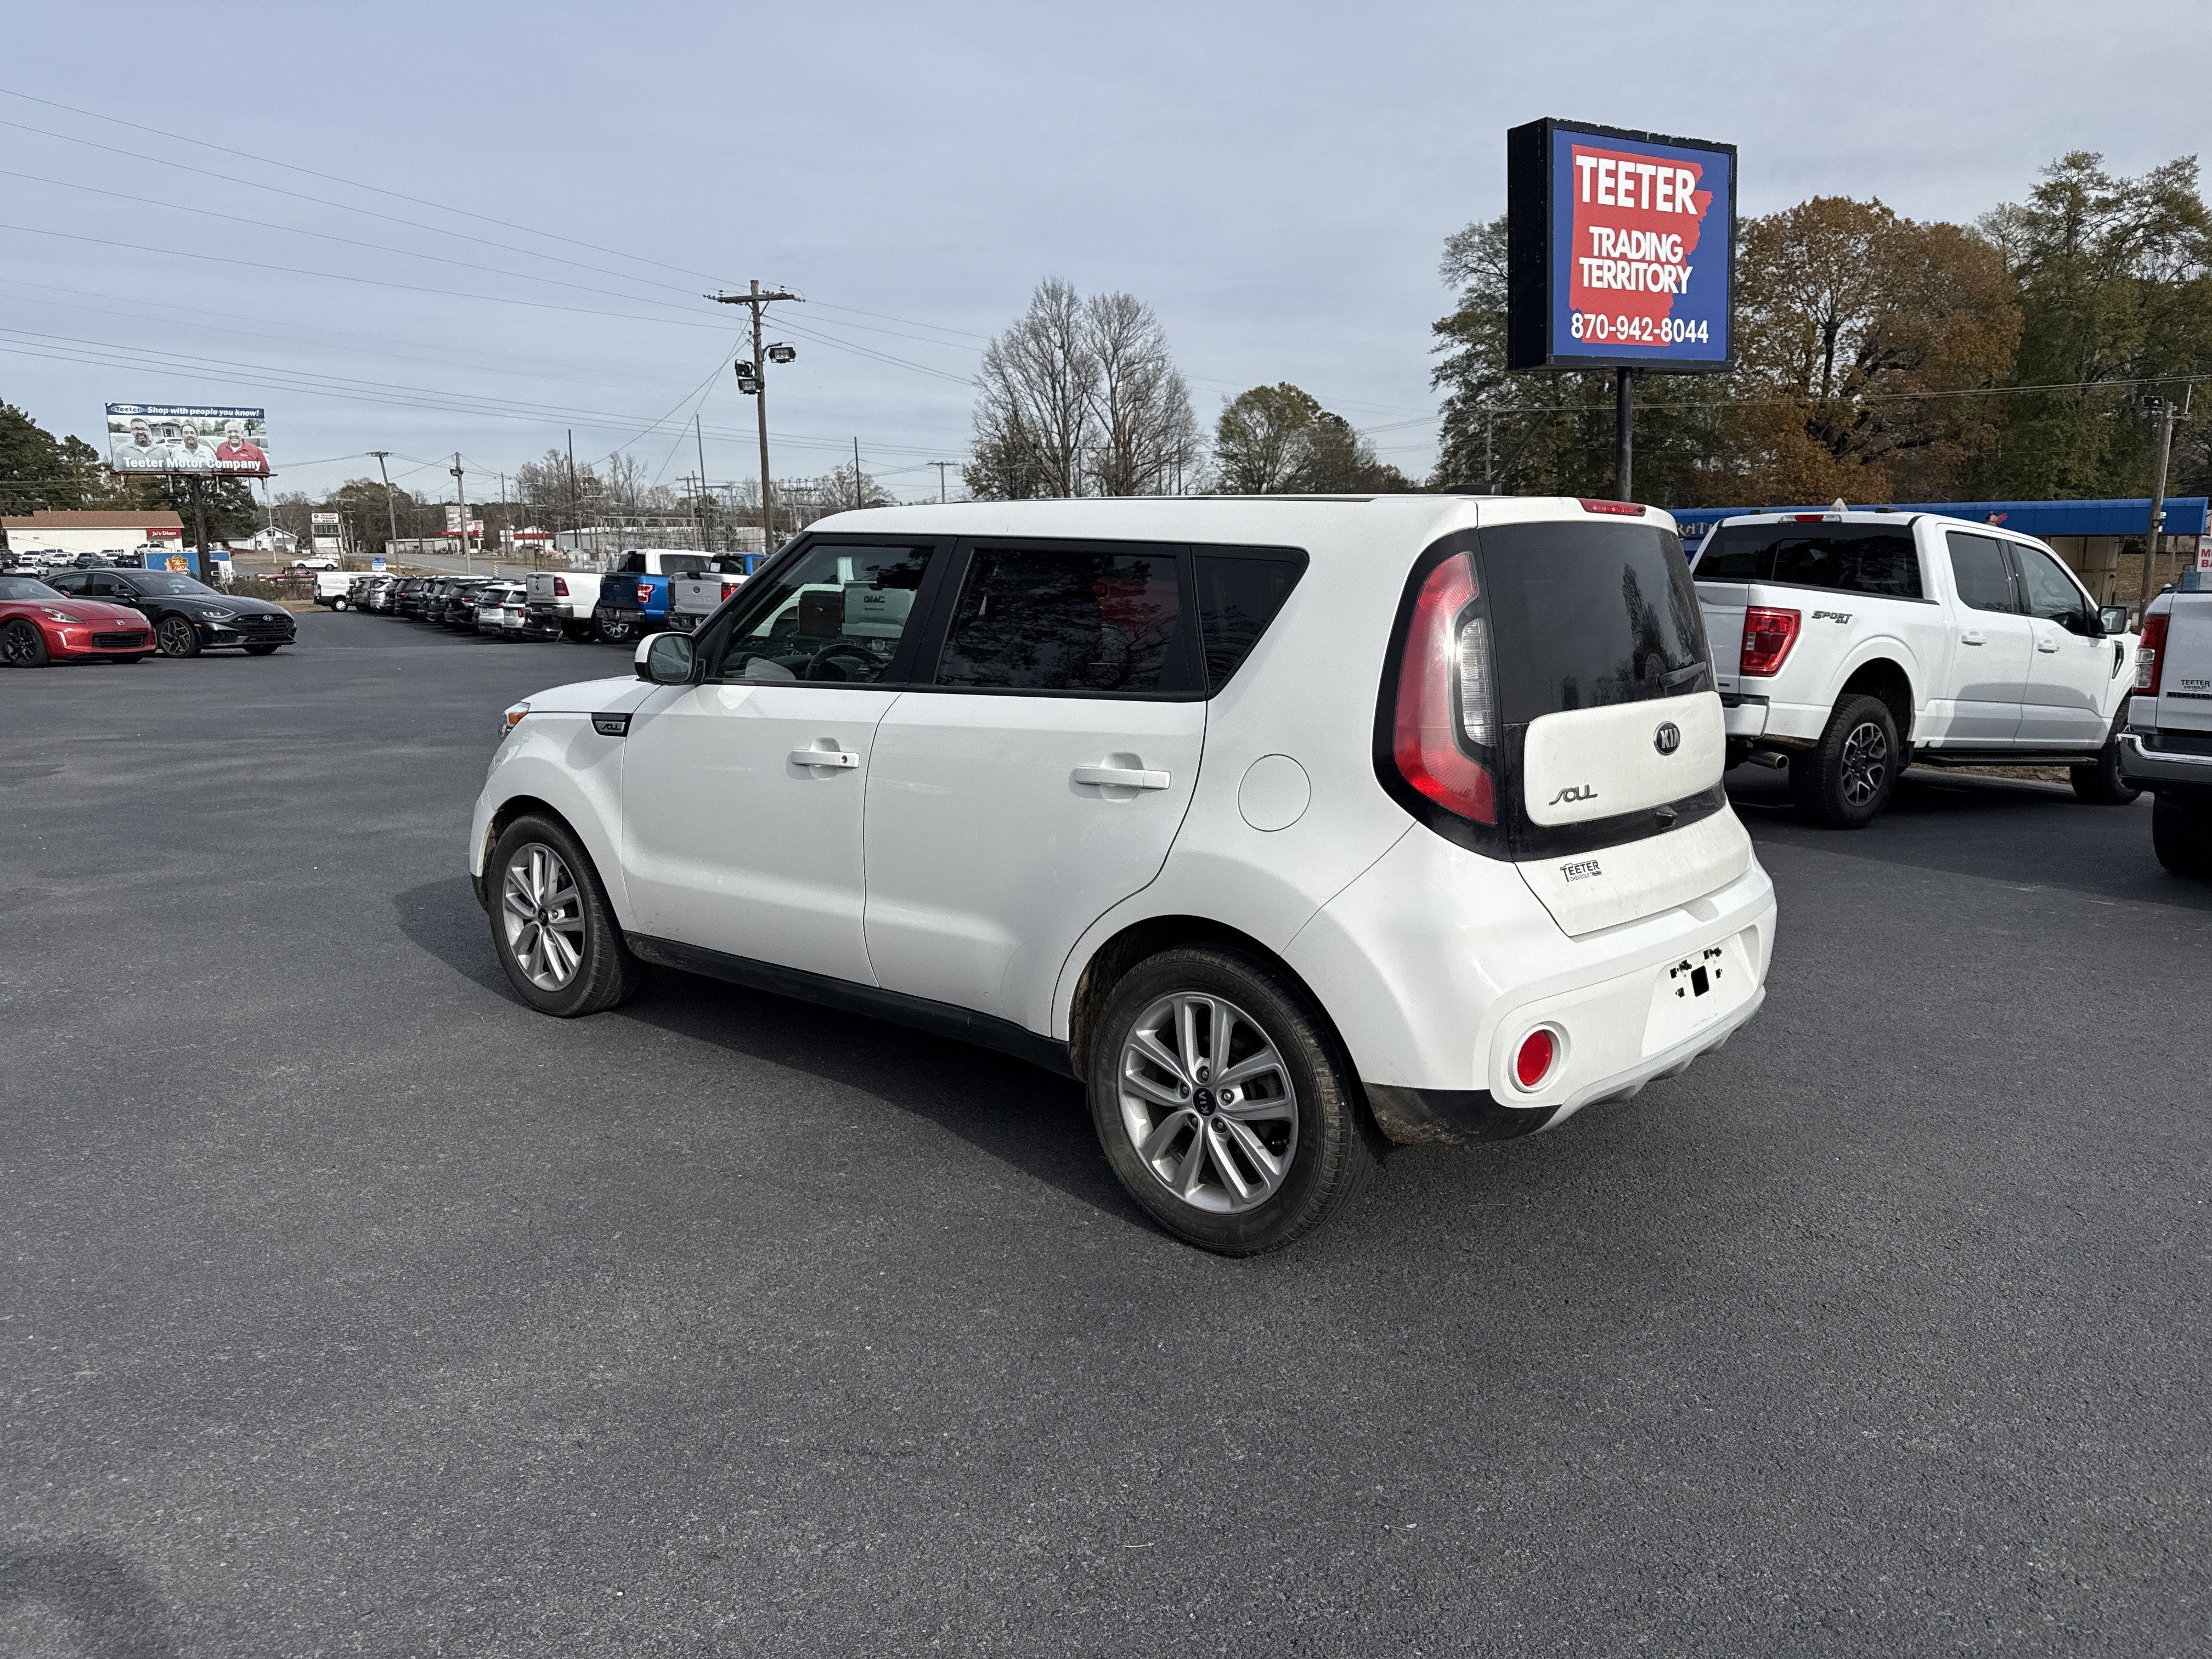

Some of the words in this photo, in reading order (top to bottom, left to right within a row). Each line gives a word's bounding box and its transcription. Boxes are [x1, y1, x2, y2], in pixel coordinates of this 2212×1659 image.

[1576, 155, 1698, 215] TEETER
[1589, 225, 1683, 263] TRADING
[1579, 257, 1693, 295] TERRITORY
[1571, 313, 1709, 343] 870-942-8044
[146, 406, 168, 415] Shop
[123, 457, 164, 468] Teeter
[166, 458, 204, 469] Motor
[206, 458, 261, 471] Company
[864, 596, 885, 604] GMC
[1812, 610, 1853, 620] SPORT
[2181, 679, 2210, 687] TEETER
[1660, 727, 1680, 749] KIA
[1561, 861, 1600, 882] TEETER
[1199, 1091, 1209, 1113] KIA
